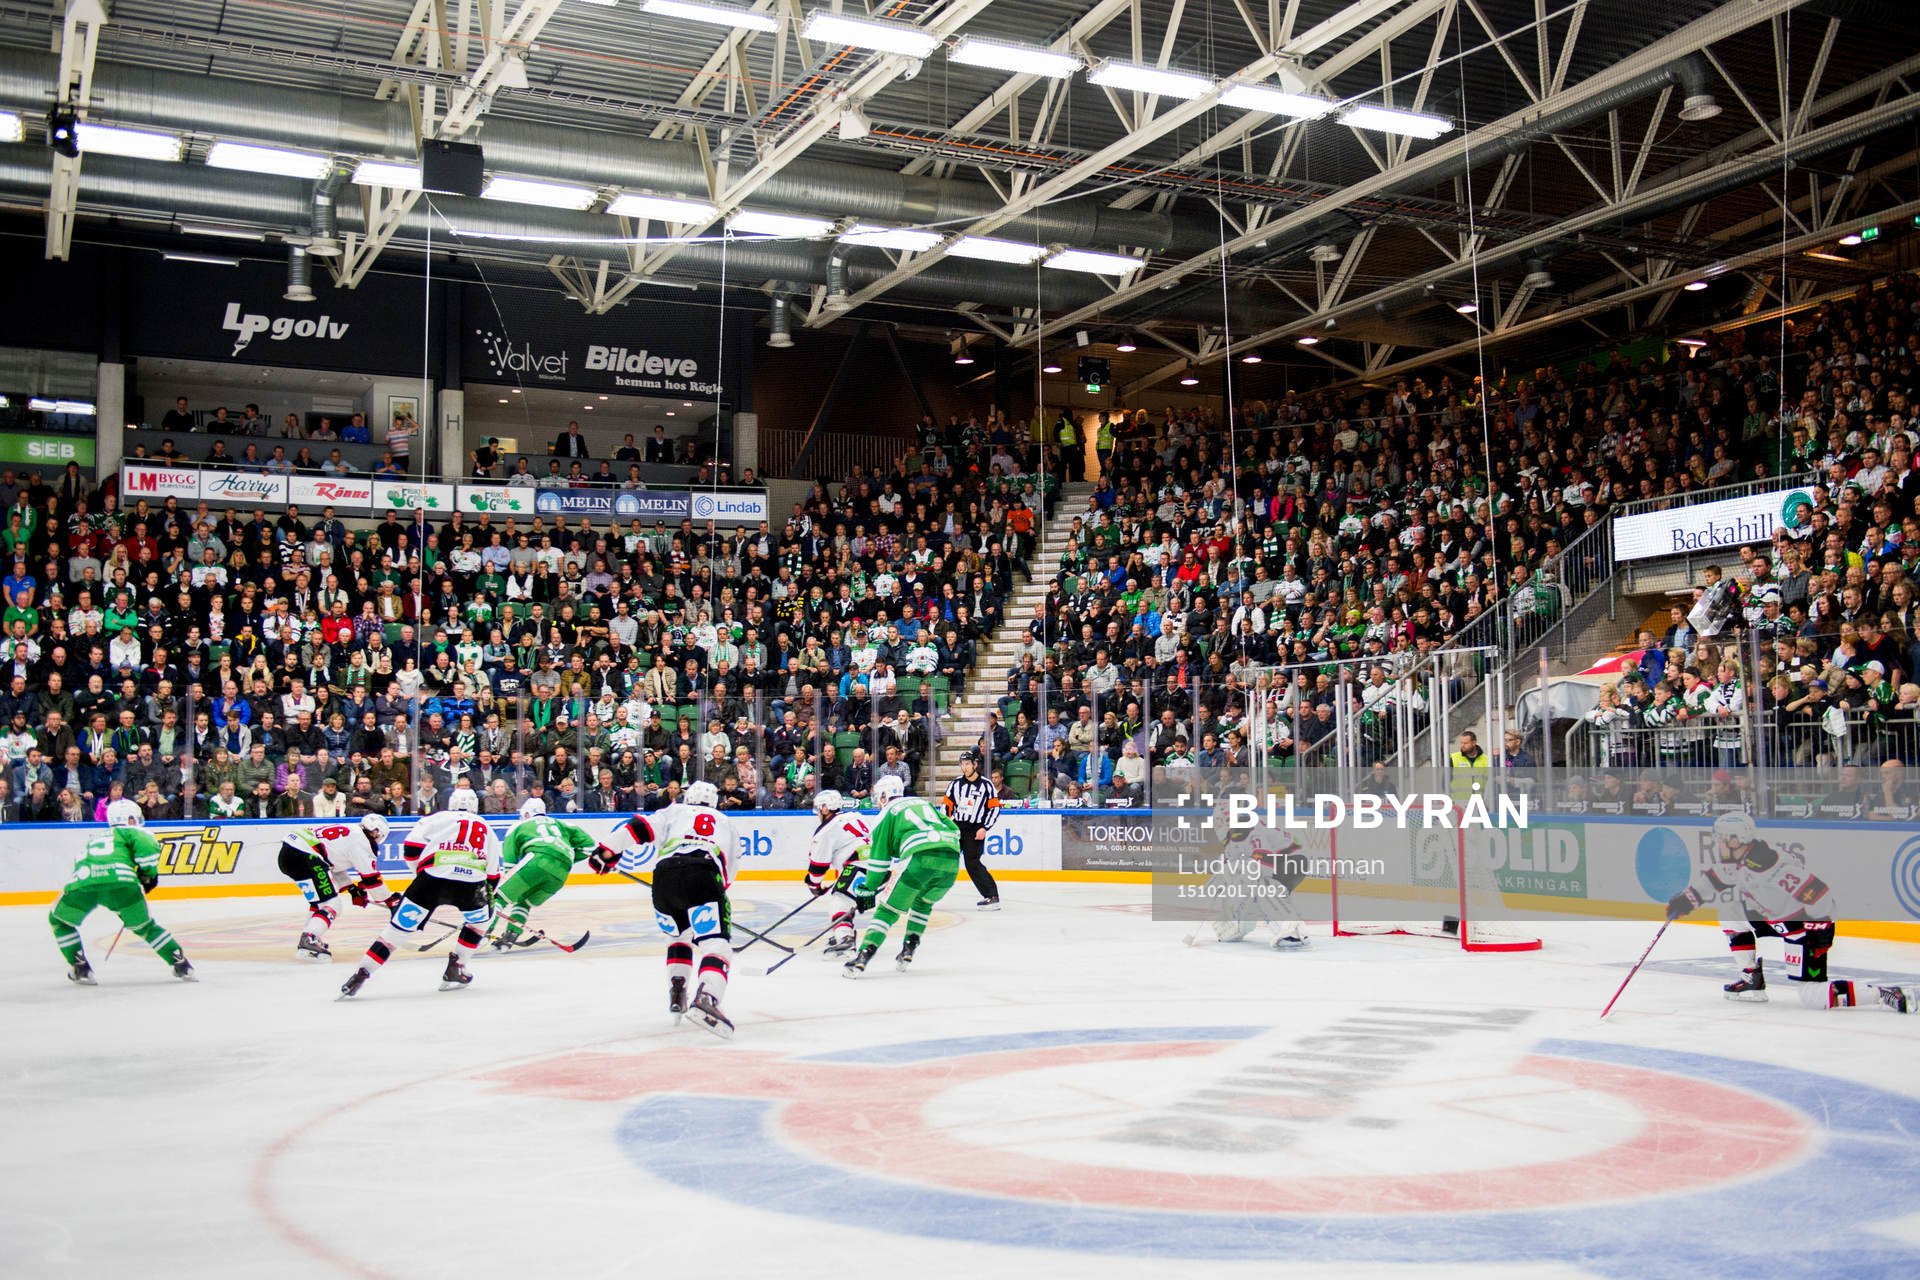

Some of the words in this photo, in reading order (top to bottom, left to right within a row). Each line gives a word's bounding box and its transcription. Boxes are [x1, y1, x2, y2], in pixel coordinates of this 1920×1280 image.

[271, 315, 350, 341] golv
[494, 340, 569, 374] Valvet
[585, 345, 698, 378] Bildeve
[615, 376, 662, 390] hemma
[665, 380, 687, 391] hos
[690, 381, 723, 396] Rögle
[128, 472, 157, 492] LM
[159, 473, 196, 484] BYGG
[208, 474, 280, 500] Harrys
[561, 496, 612, 509] MELIN
[640, 498, 689, 511] MELIN
[717, 501, 761, 514] Lindab
[1672, 513, 1773, 552] Backahill
[693, 813, 716, 837] 6
[1088, 826, 1155, 842] TOREKOV
[1159, 827, 1208, 843] HOTELL
[739, 829, 773, 857] ab
[986, 828, 1024, 856] ab
[1095, 844, 1110, 852] SPA,
[1478, 827, 1580, 875] OLID
[158, 837, 244, 876] LLIN
[1496, 874, 1581, 892] KRINGAR
[1778, 872, 1802, 895] 23
[1785, 954, 1802, 965] AXI
